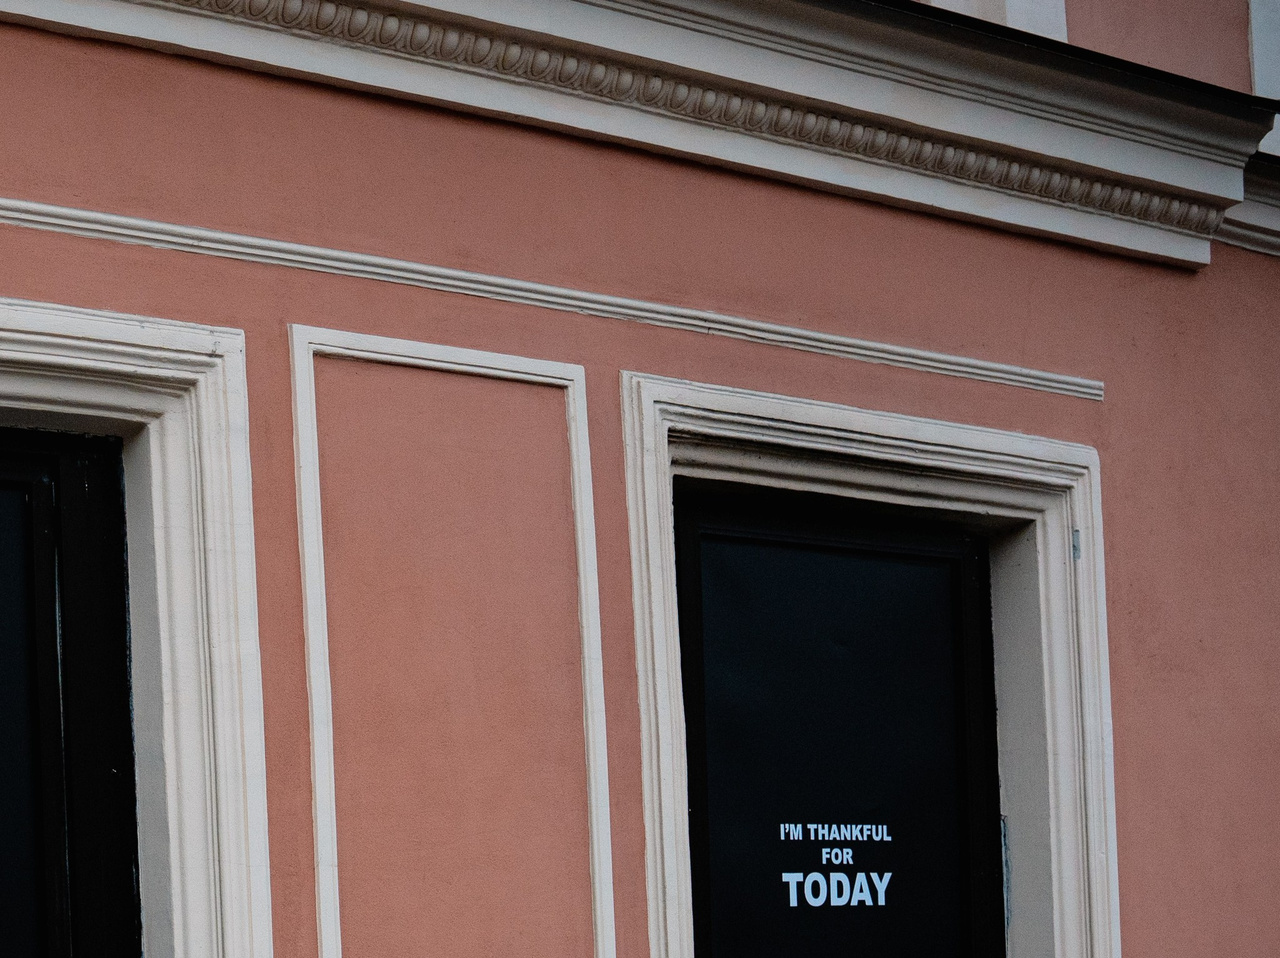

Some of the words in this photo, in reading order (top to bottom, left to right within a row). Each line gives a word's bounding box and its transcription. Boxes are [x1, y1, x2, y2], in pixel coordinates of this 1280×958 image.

[780, 823, 803, 841] I’M
[807, 824, 892, 841] THANKFUL
[822, 848, 854, 865] FOR
[782, 872, 892, 907] TODAY
